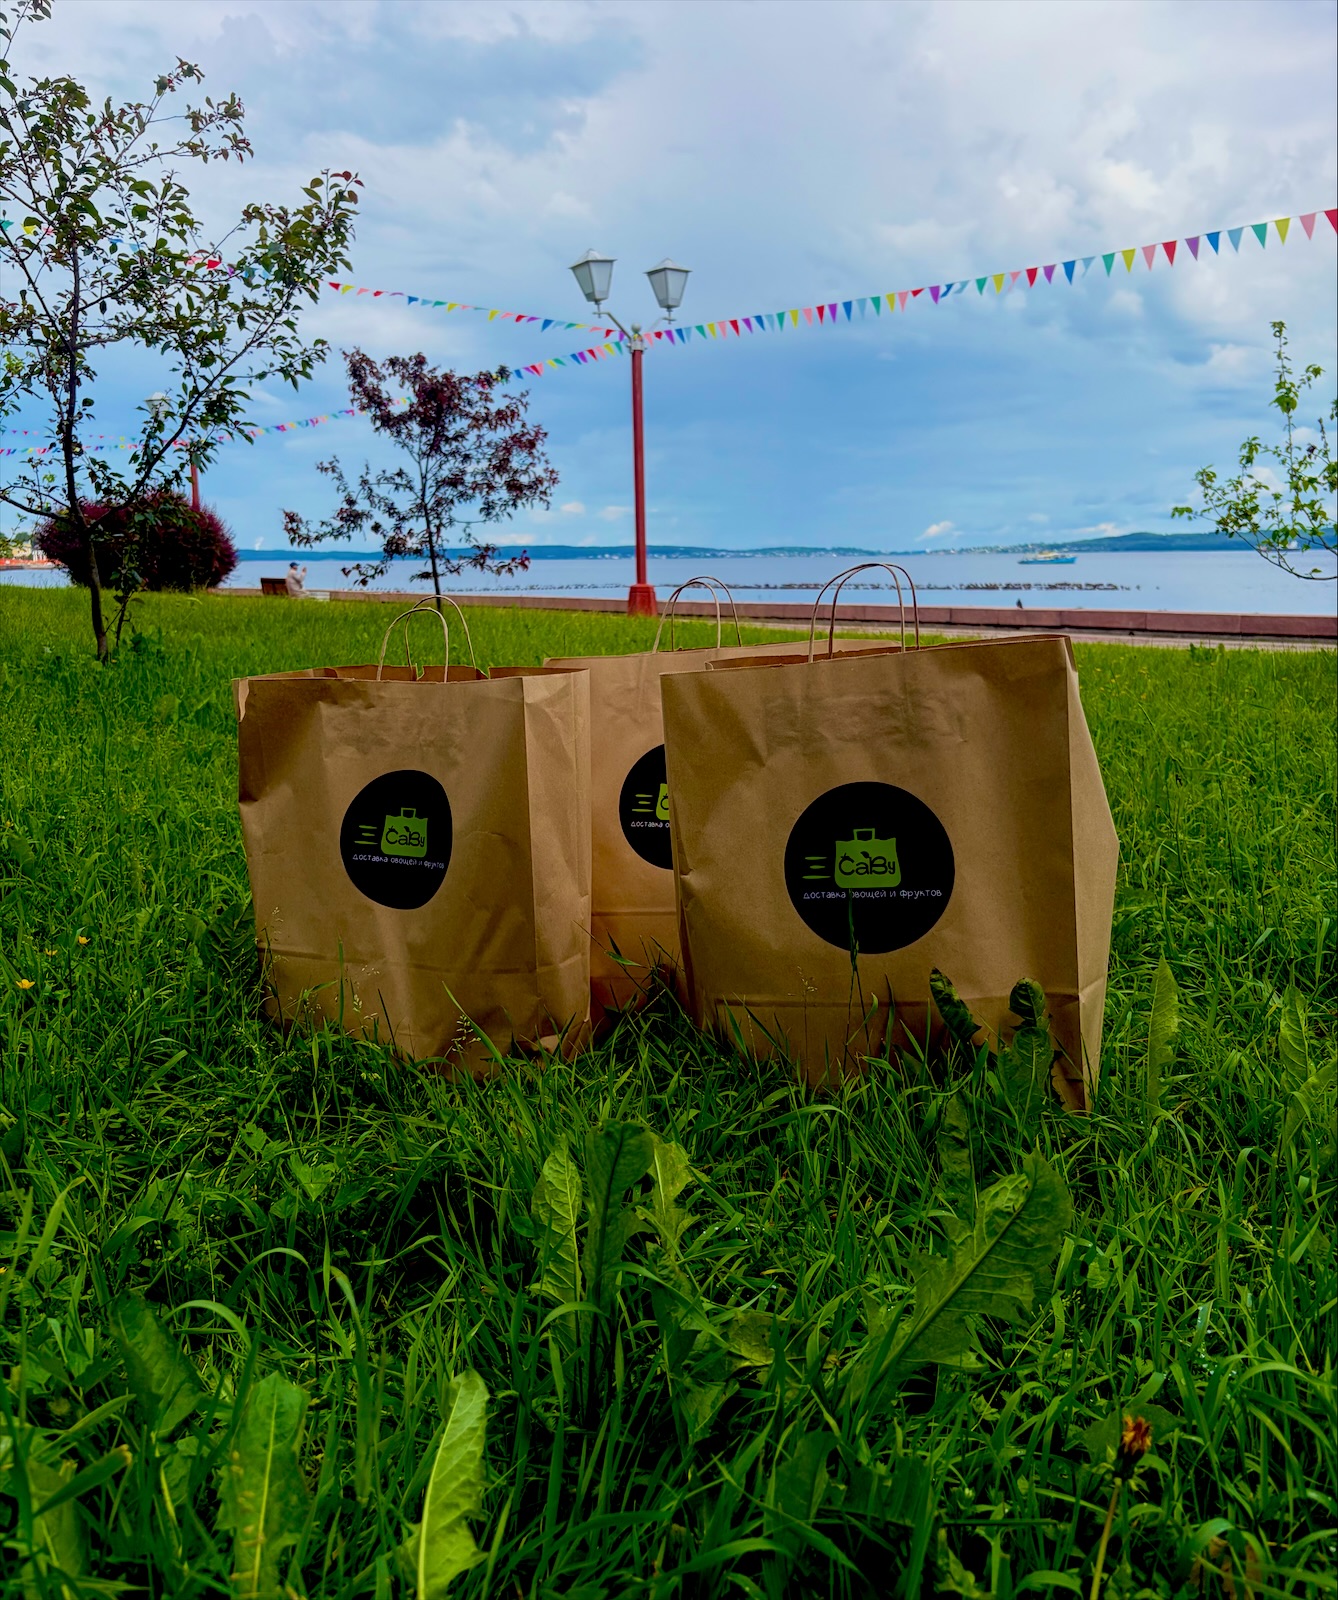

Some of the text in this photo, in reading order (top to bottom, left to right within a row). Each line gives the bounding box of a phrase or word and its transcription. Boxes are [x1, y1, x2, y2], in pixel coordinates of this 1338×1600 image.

[352, 854, 388, 863] доставка
[390, 857, 417, 866] овощей
[424, 860, 445, 869] фруктов
[803, 890, 847, 899] доставка
[899, 889, 943, 899] фруктов
